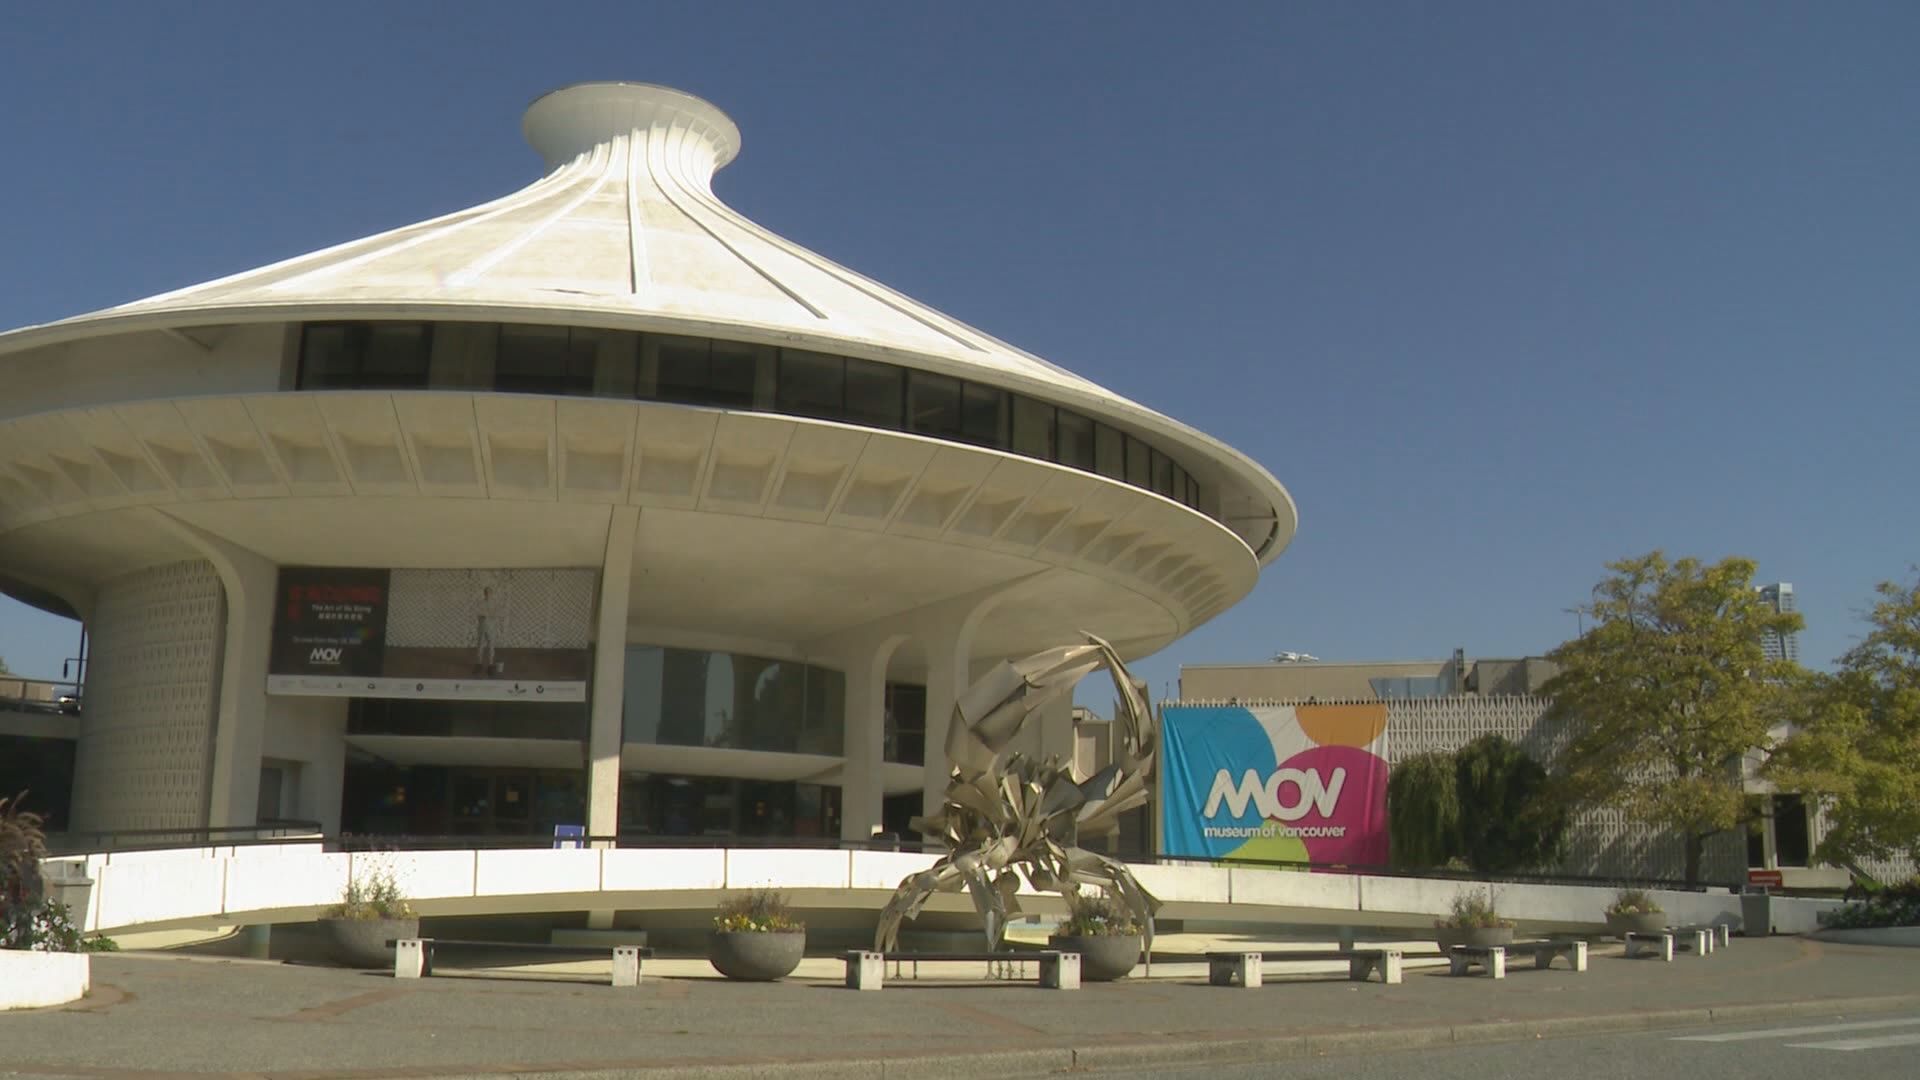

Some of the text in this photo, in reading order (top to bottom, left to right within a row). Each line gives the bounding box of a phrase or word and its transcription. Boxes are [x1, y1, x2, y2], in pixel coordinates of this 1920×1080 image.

[310, 647, 343, 661] MOV
[1203, 767, 1347, 821] MOV
[1204, 826, 1346, 838] museum of vancouver
